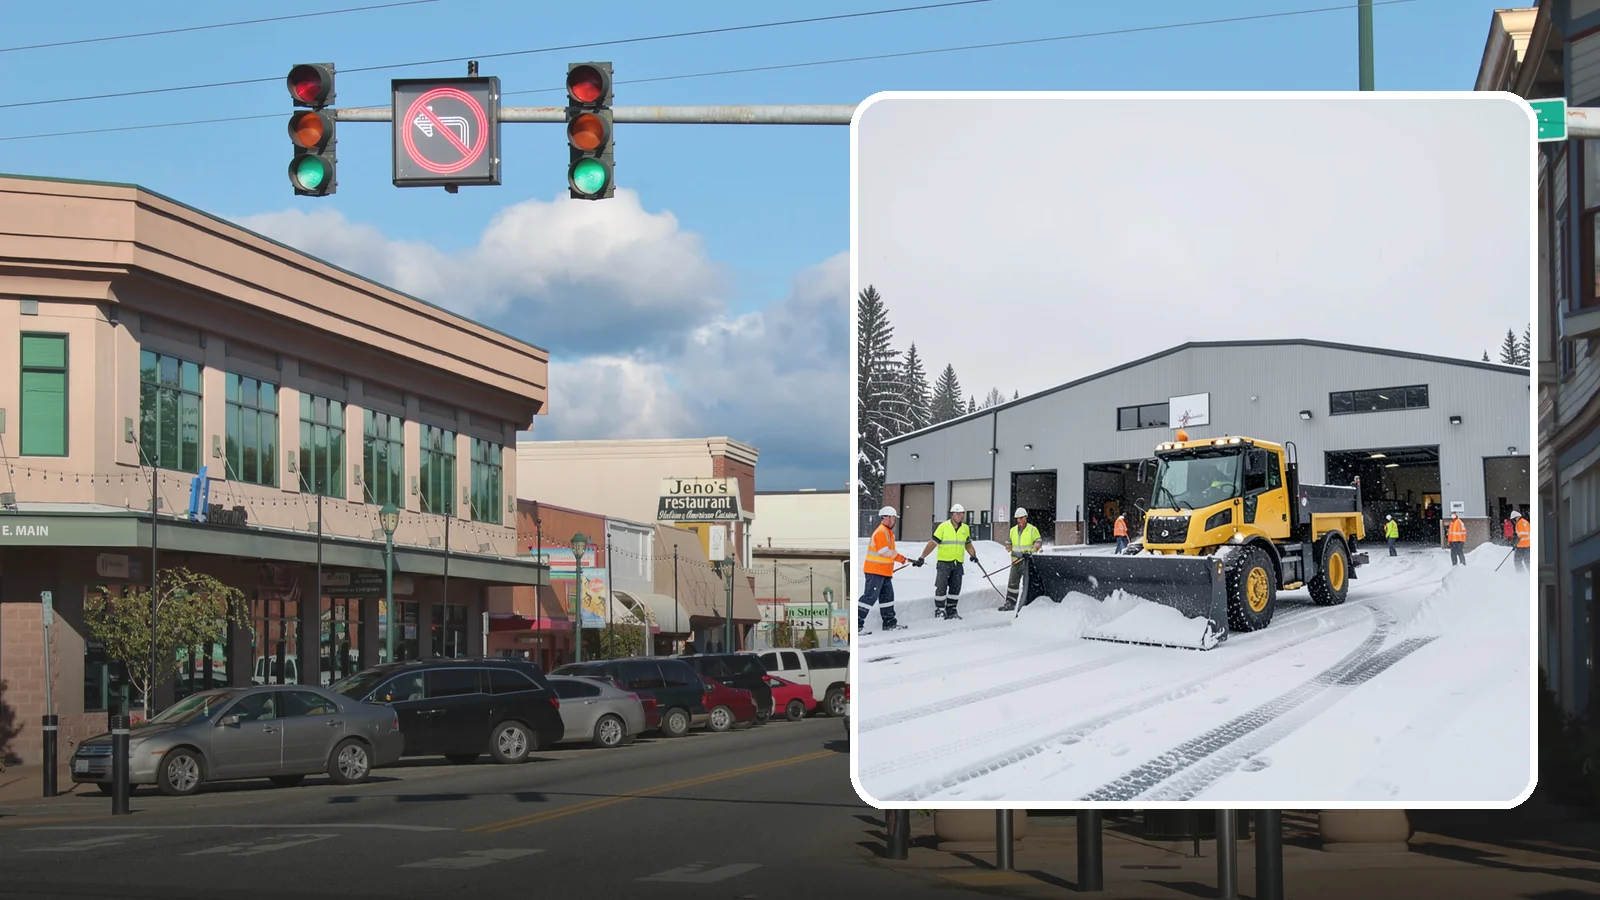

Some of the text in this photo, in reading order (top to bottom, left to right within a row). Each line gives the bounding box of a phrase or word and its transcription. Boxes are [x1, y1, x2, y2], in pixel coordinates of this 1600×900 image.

[670, 480, 727, 494] Jeno's
[665, 496, 731, 509] restaurant
[658, 510, 682, 520] Italian
[686, 510, 714, 520] American
[715, 509, 737, 520] Cuisine
[2, 525, 49, 536] E. MAIN
[797, 607, 829, 616] Street
[791, 619, 823, 627] lass
